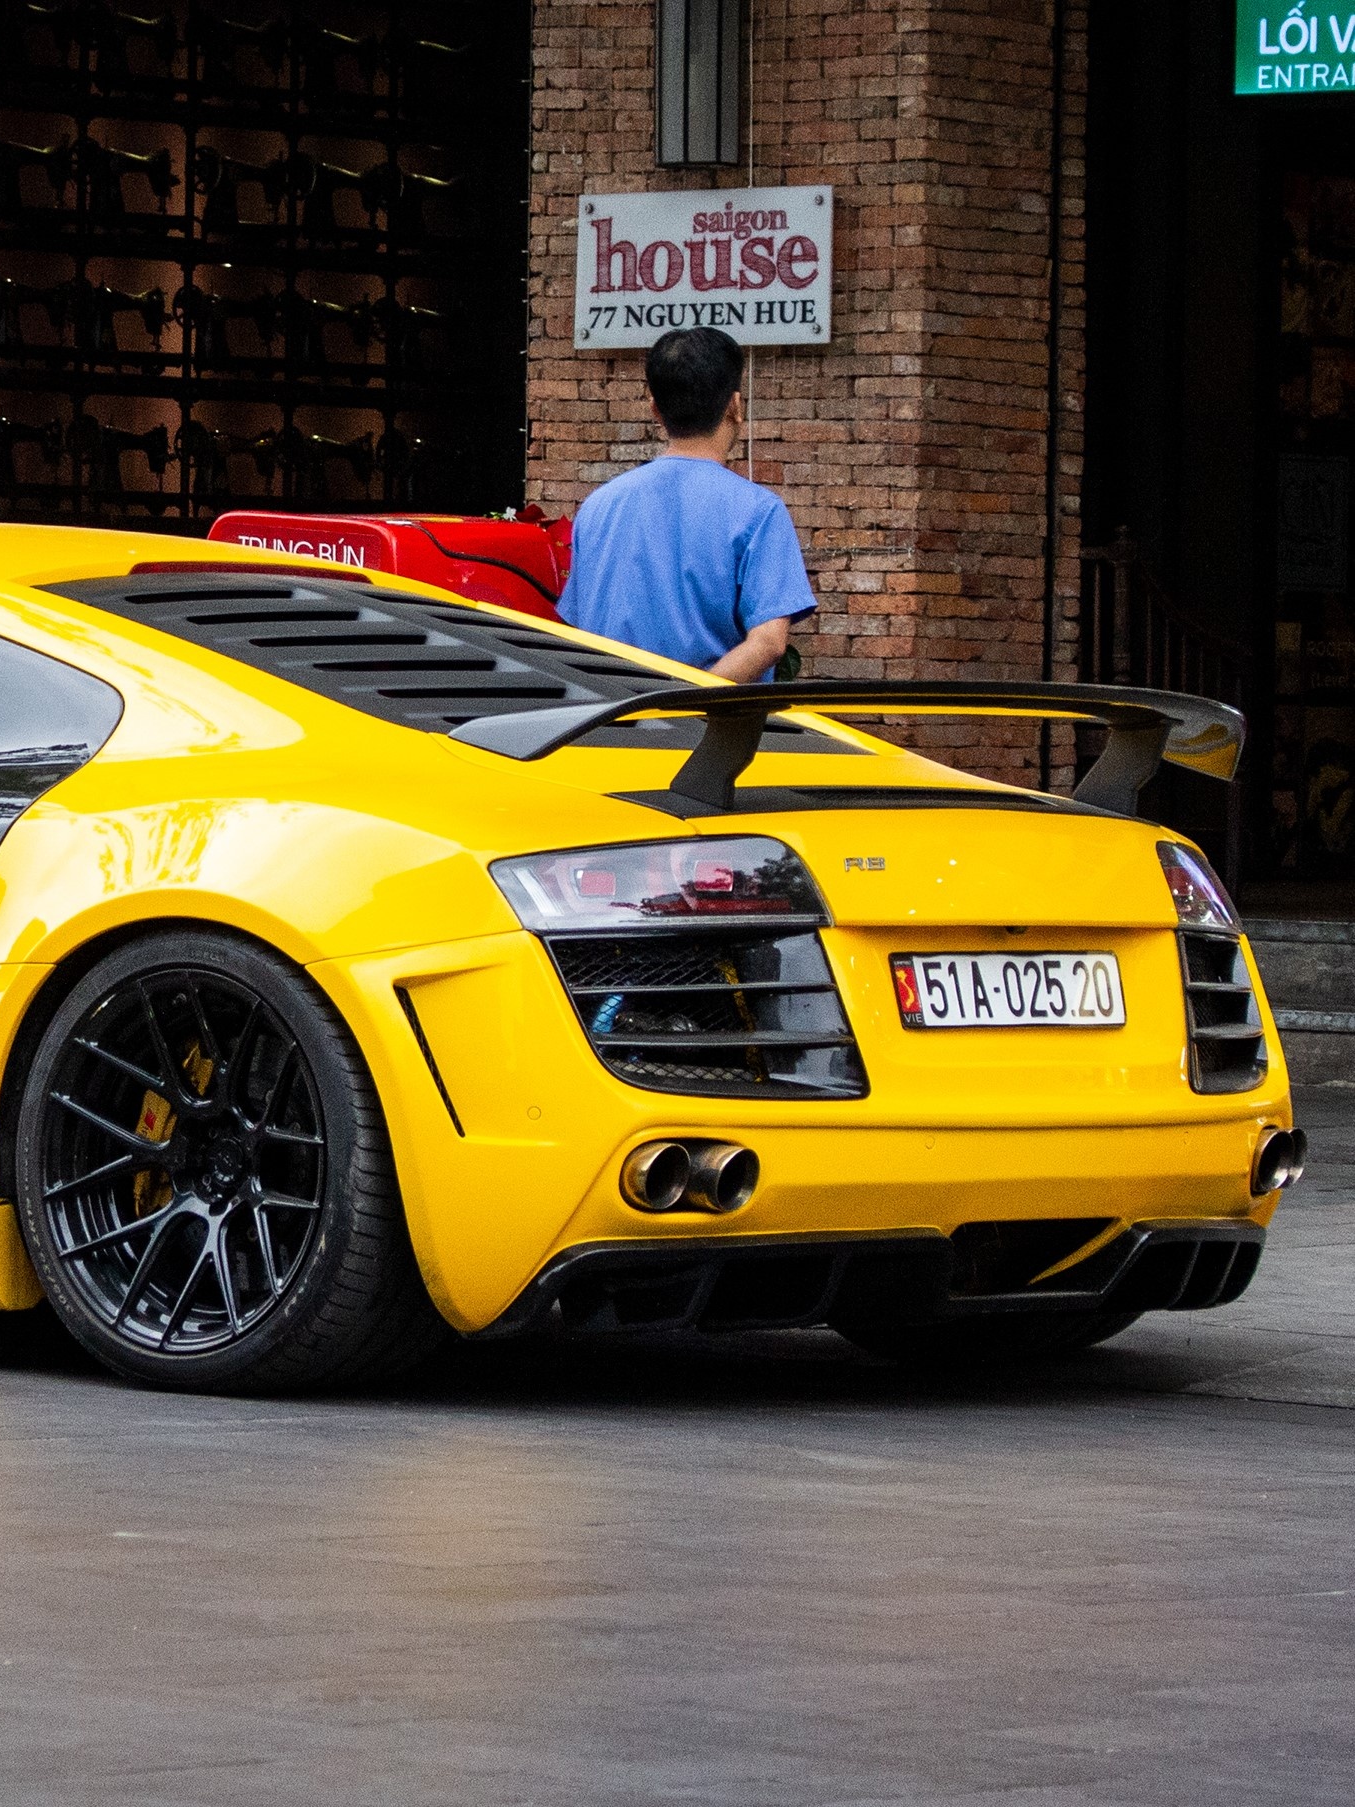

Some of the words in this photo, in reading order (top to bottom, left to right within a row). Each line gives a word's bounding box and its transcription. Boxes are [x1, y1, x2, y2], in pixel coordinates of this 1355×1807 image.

[1259, 0, 1318, 54] LỐI
[1329, 14, 1355, 53] V
[1258, 62, 1355, 89] ENTRA
[692, 202, 789, 240] saigon
[590, 216, 820, 294] house
[589, 306, 617, 329] 77
[624, 302, 747, 328] NGUYEN
[754, 300, 817, 325] HUE
[845, 857, 885, 872] R8
[903, 1013, 923, 1024] VIE
